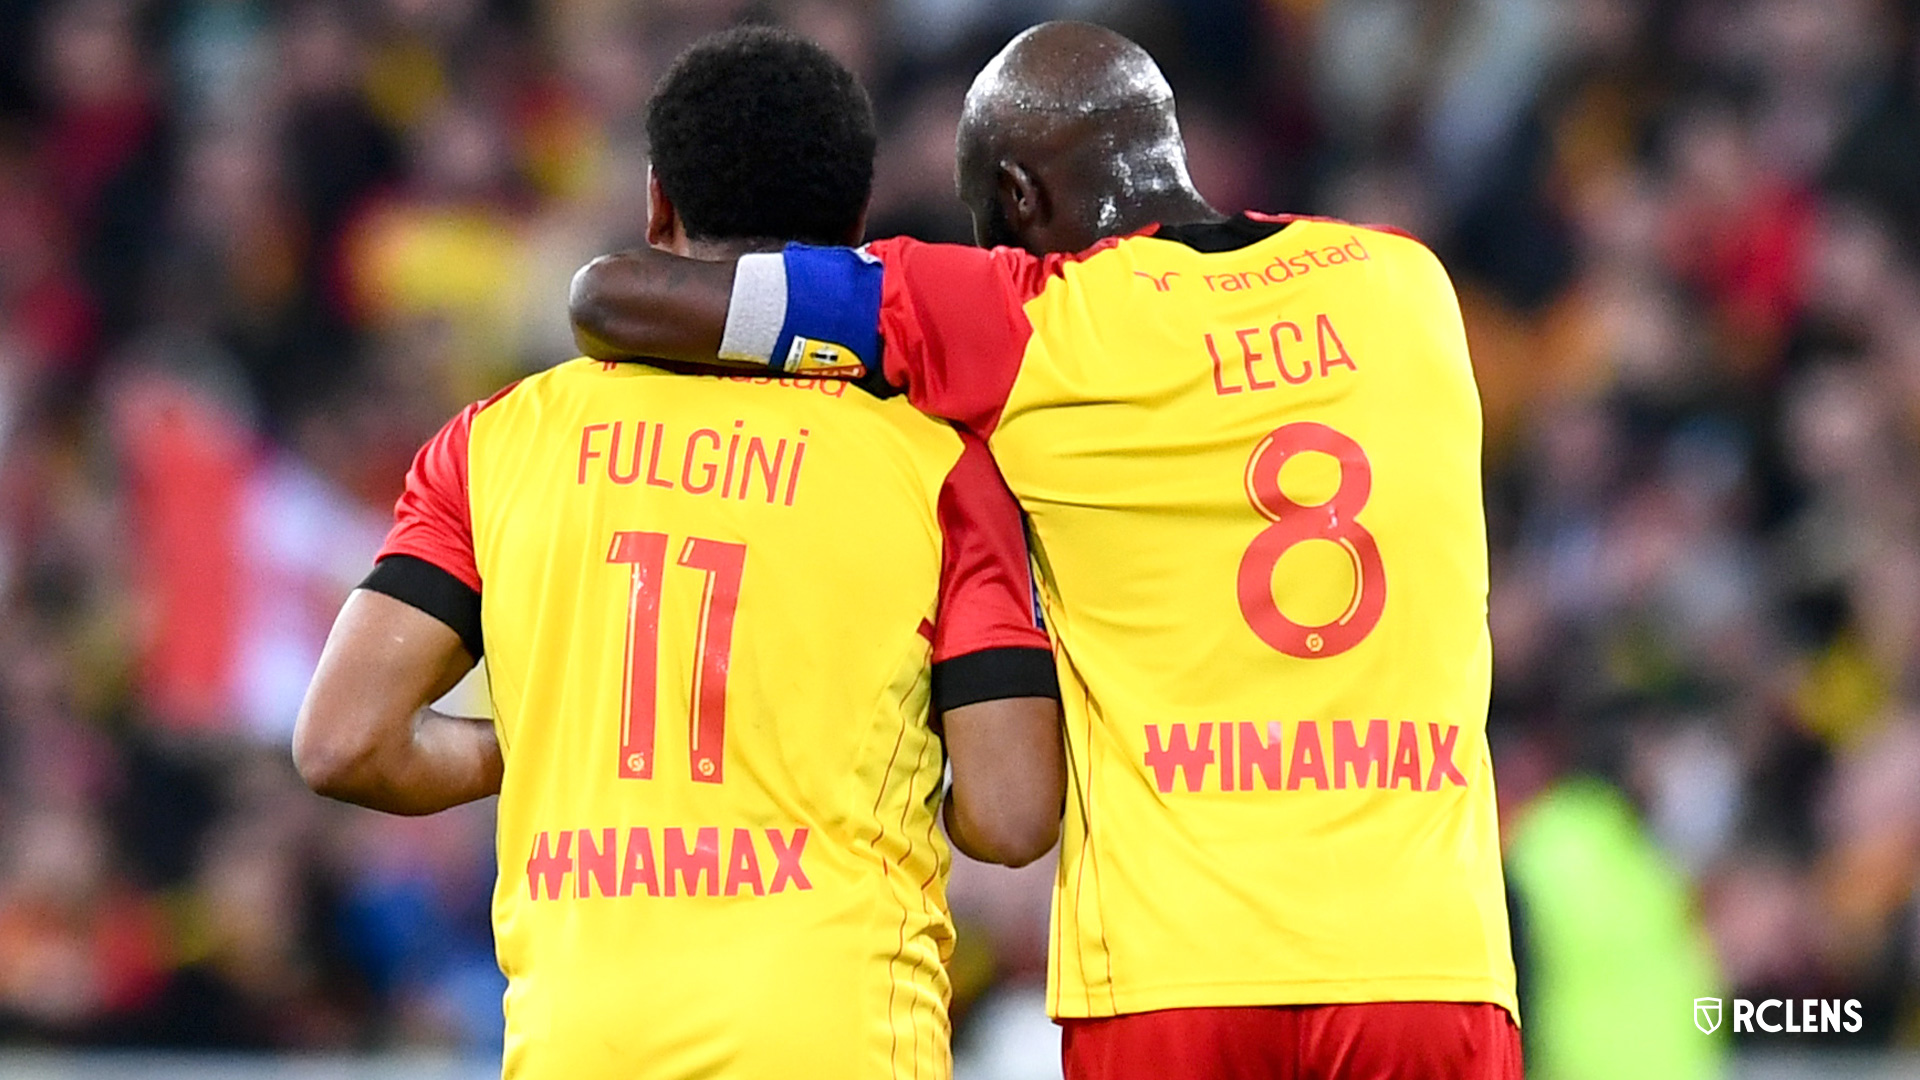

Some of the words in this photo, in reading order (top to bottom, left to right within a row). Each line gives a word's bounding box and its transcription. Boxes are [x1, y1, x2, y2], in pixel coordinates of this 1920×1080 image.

[1203, 236, 1370, 292] randstad
[1204, 313, 1357, 396] LECA
[1236, 421, 1387, 660] 8
[605, 530, 748, 785] 11
[1143, 718, 1469, 794] WINAMAX
[526, 826, 814, 901] WNAMAX
